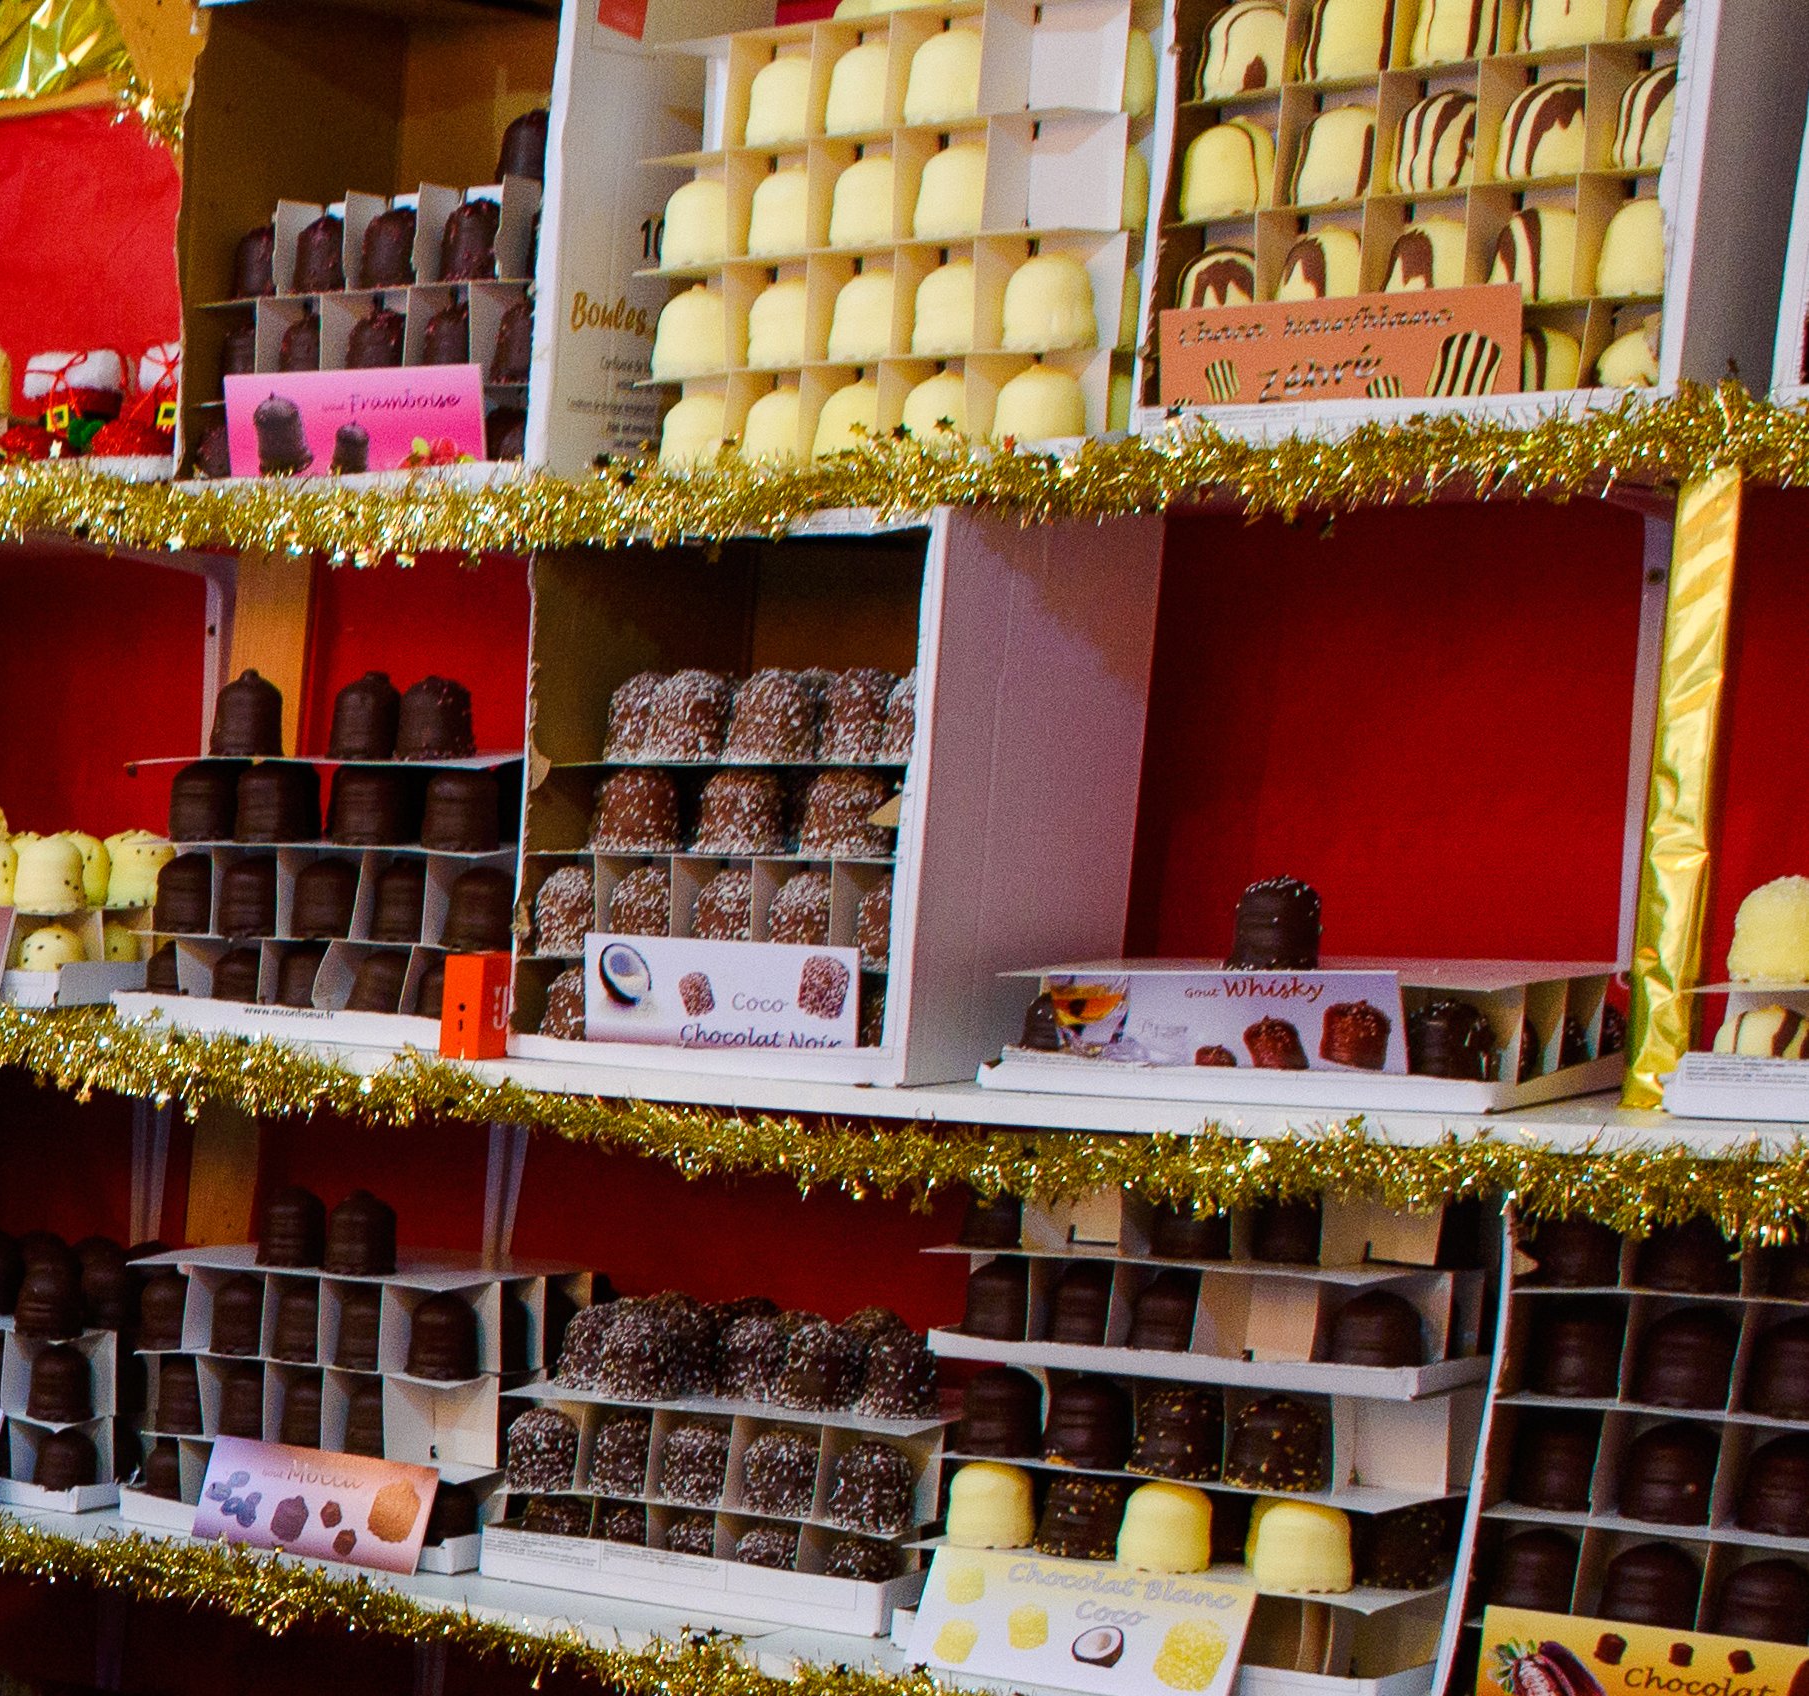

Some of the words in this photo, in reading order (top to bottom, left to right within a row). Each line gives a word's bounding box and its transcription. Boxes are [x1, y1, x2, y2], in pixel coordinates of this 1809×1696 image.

[570, 291, 647, 336] Boules
[1222, 976, 1325, 1003] Whisky
[732, 993, 785, 1013] Coco
[680, 1023, 782, 1049] Chocolat
[1007, 1561, 1142, 1598] Chocolat
[1143, 1578, 1238, 1610] Blanc
[1075, 1600, 1150, 1626] Coco
